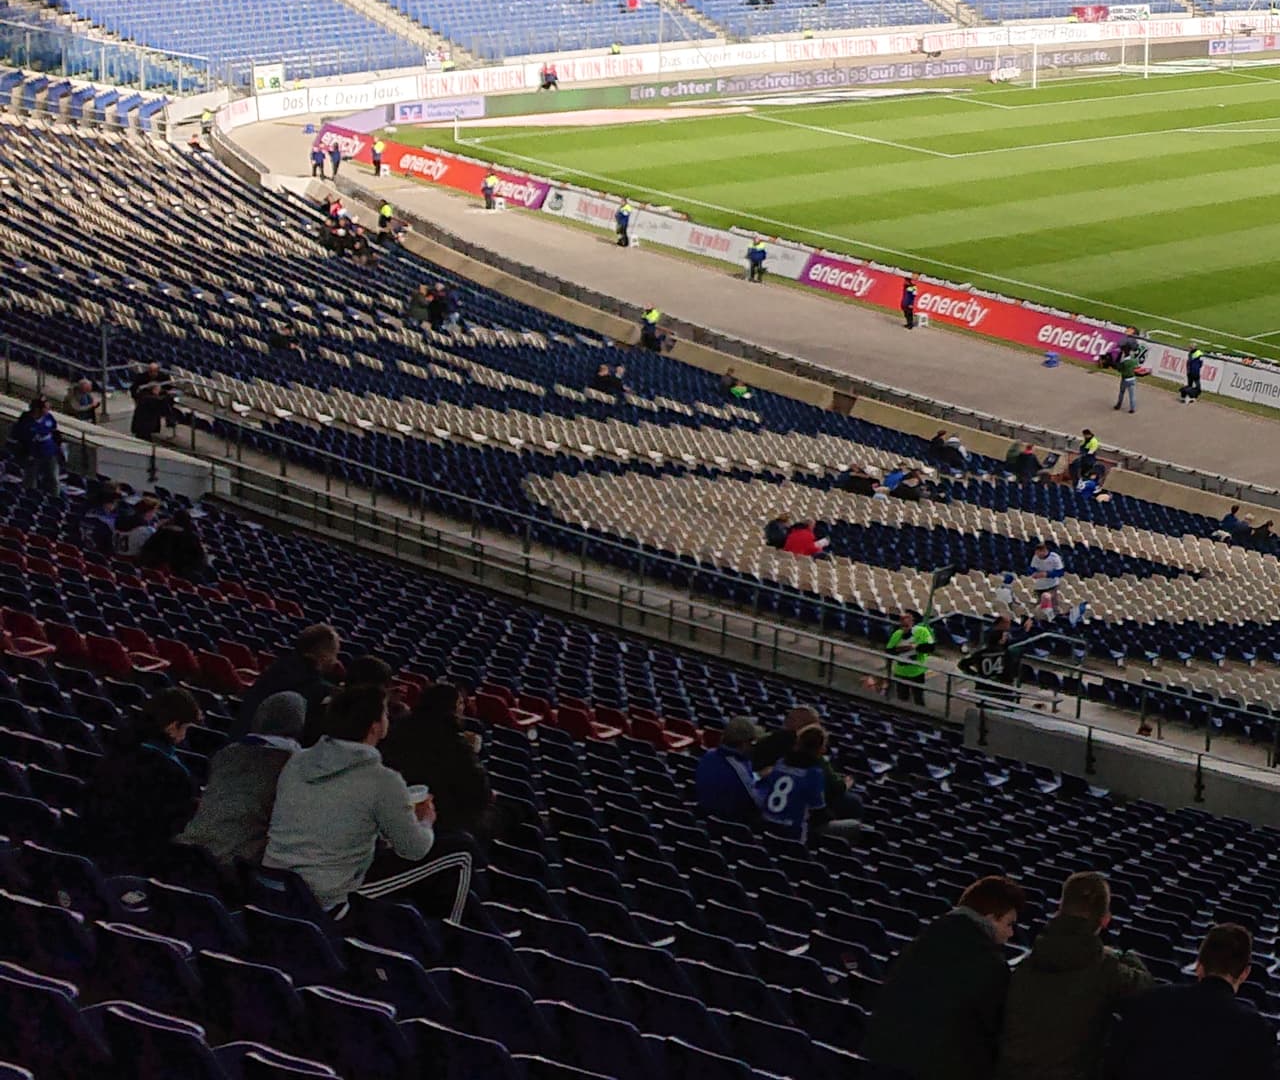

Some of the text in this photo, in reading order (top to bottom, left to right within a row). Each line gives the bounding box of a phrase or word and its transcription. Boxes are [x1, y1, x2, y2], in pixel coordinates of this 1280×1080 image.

[421, 76, 454, 96] HEINZ
[483, 68, 525, 90] HEIDEN
[630, 84, 657, 100] Ein
[660, 81, 713, 97] echter
[717, 77, 746, 93] Fan
[749, 72, 813, 92] schreibt
[816, 69, 846, 86] sich
[870, 66, 897, 81] auf
[900, 63, 923, 78] die
[399, 152, 448, 179] enercity
[494, 179, 541, 204] nercity
[808, 261, 874, 297] enercity
[917, 291, 988, 329] enercity
[1037, 325, 1114, 361] enercity
[982, 657, 1003, 675] 04
[768, 776, 793, 813] 8
